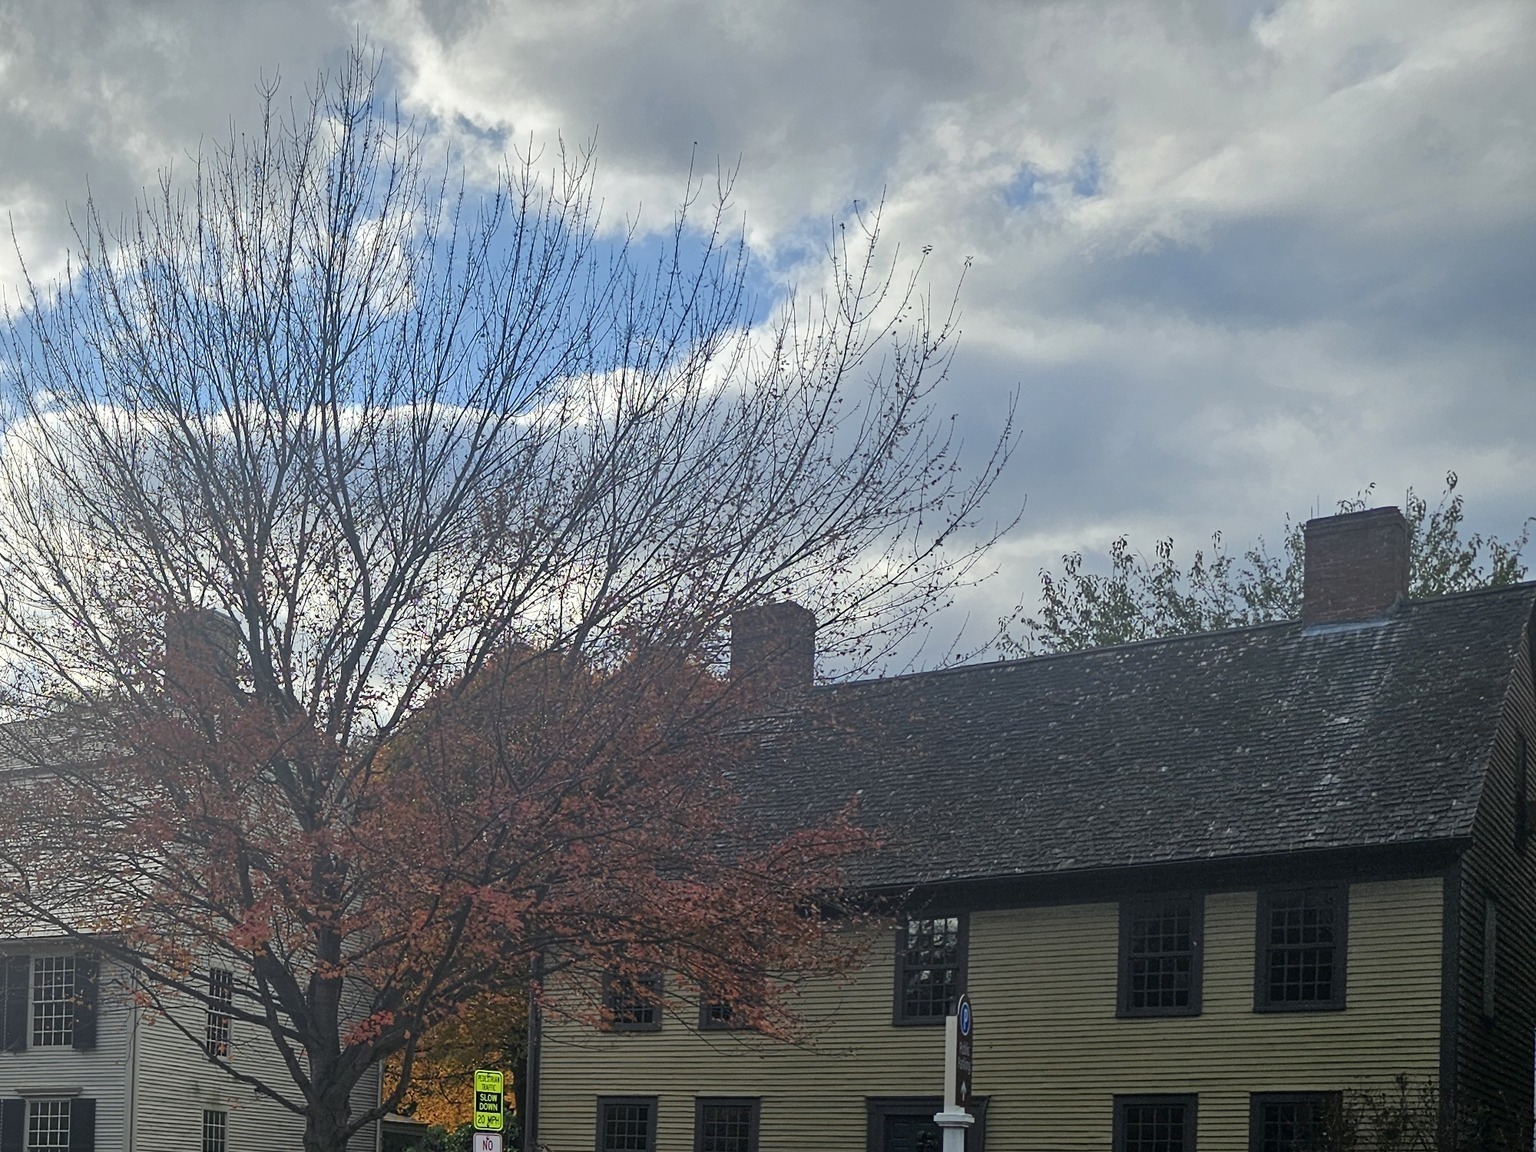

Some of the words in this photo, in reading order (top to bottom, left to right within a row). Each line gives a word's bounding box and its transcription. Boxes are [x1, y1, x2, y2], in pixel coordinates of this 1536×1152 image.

[481, 1084, 496, 1092] TRAFFIC
[479, 1093, 498, 1102] SLOW
[479, 1102, 498, 1111] DOWN
[477, 1114, 485, 1124] 20
[487, 1115, 500, 1125] MPH
[483, 1139, 493, 1151] NO
